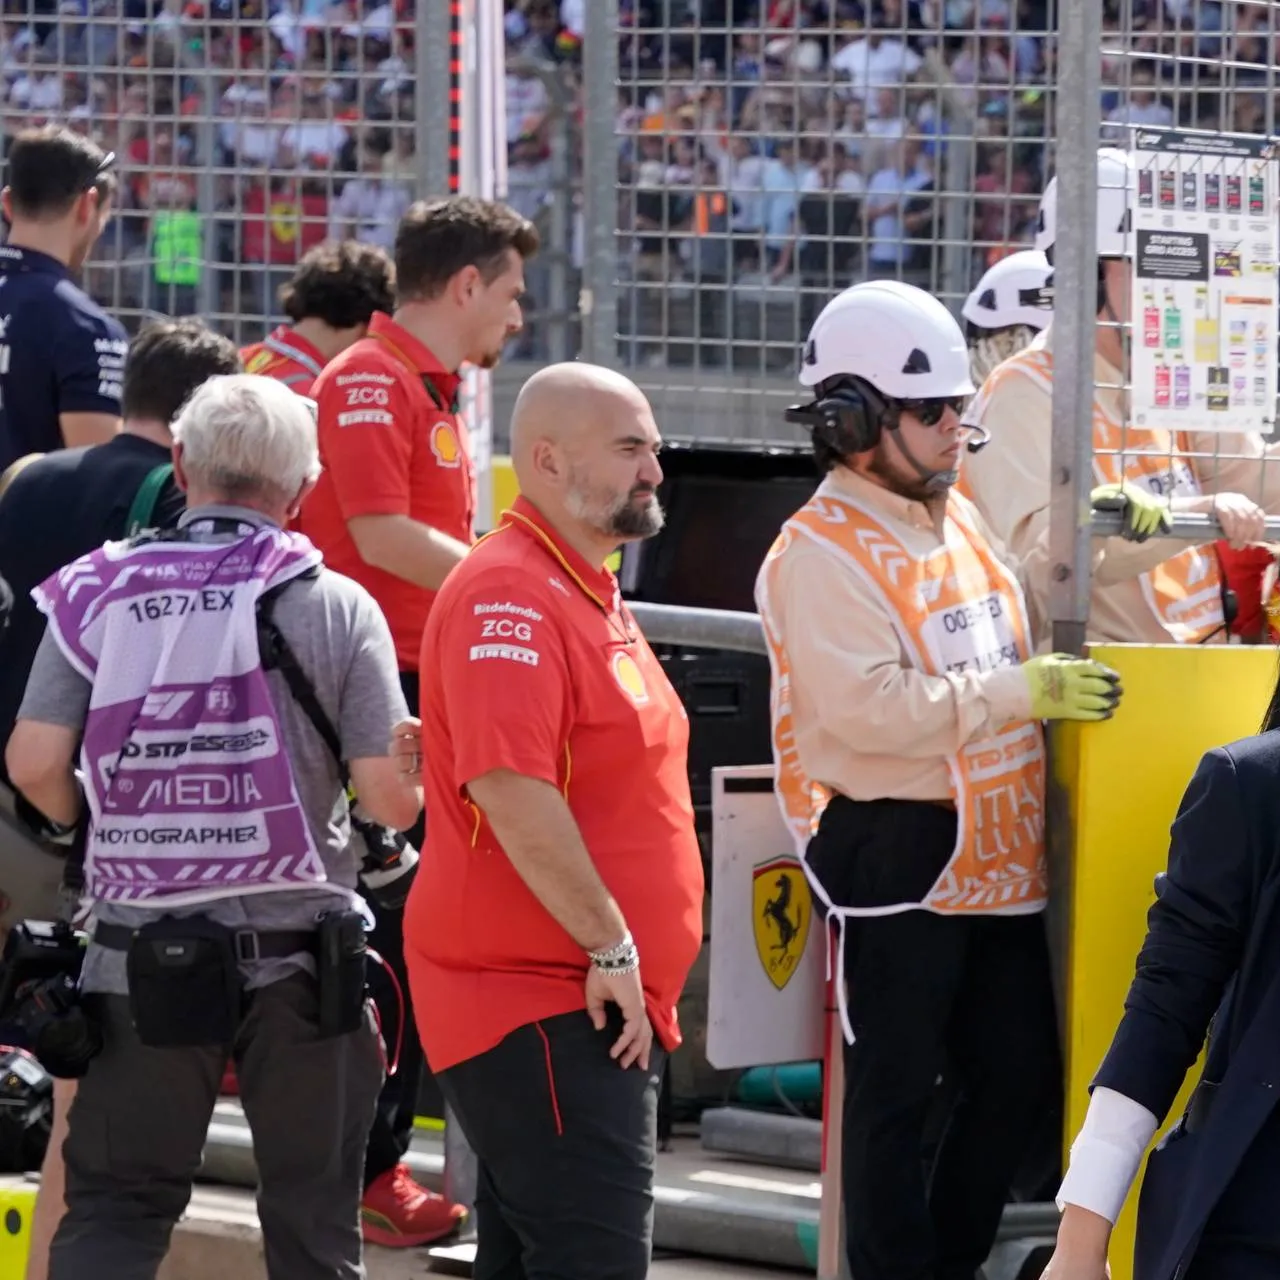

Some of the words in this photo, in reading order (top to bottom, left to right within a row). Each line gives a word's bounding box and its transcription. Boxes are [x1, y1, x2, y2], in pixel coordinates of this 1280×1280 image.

[345, 387, 389, 406] ZCG
[474, 601, 543, 622] Bitdefender
[481, 618, 532, 642] ZCG
[138, 772, 262, 809] MEDIA
[95, 825, 258, 845] HOTOGRAPHER
